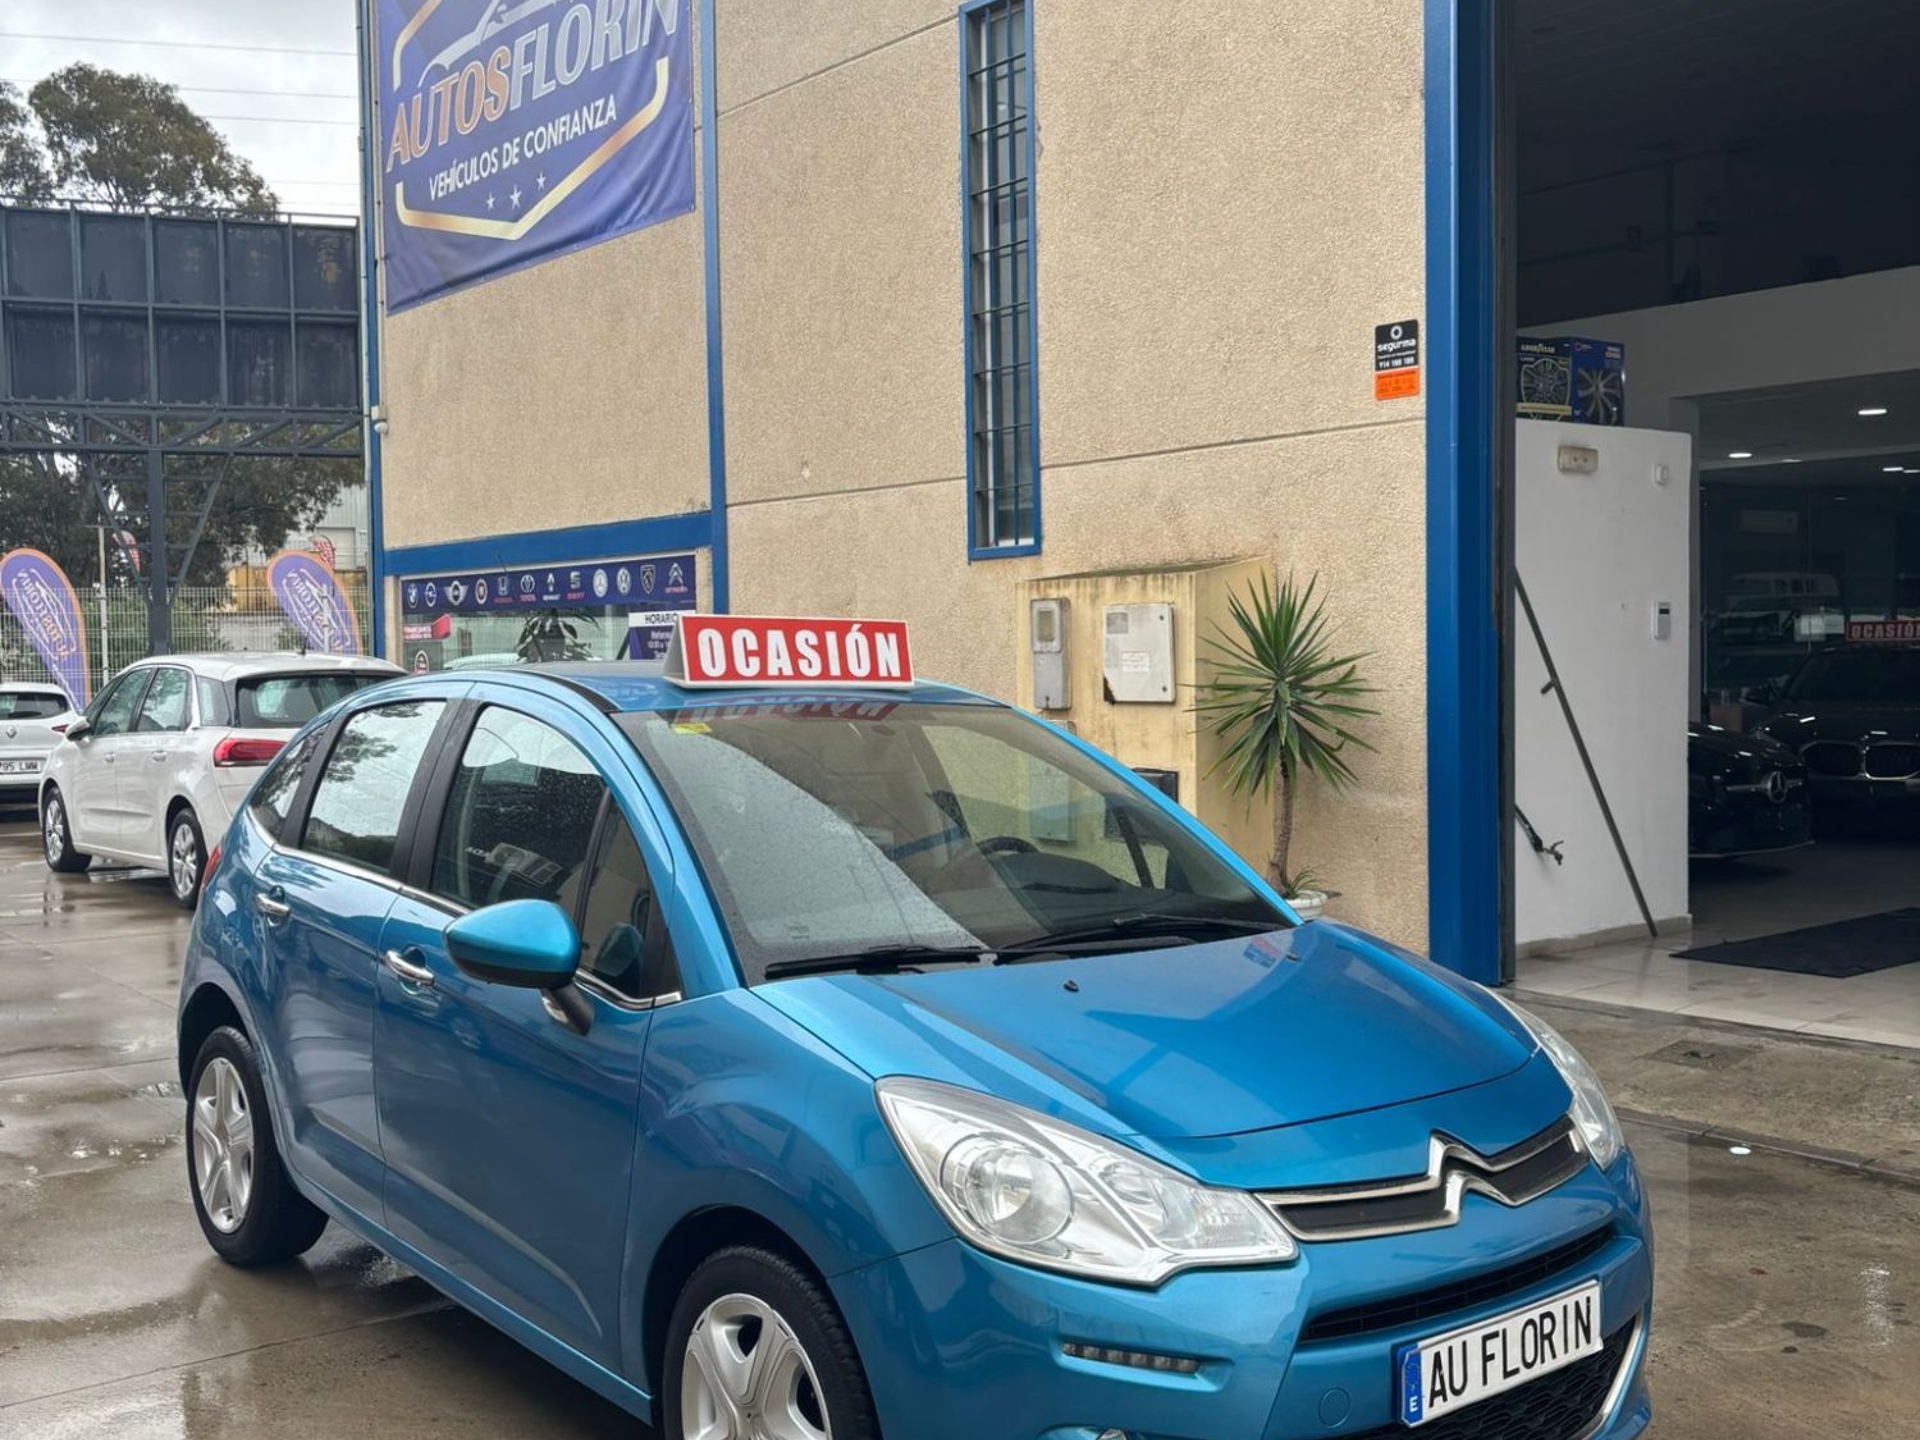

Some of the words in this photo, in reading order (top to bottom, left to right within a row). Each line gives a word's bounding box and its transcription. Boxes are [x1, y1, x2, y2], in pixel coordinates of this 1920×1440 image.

[430, 147, 498, 200] VEHÍCULOS
[502, 136, 520, 169] DE
[524, 94, 616, 158] CONFIANZA
[698, 624, 901, 678] OCASIÓN
[1429, 1341, 1468, 1408] AU
[1482, 1296, 1591, 1387] FLORIN
[1410, 1396, 1418, 1412] E
